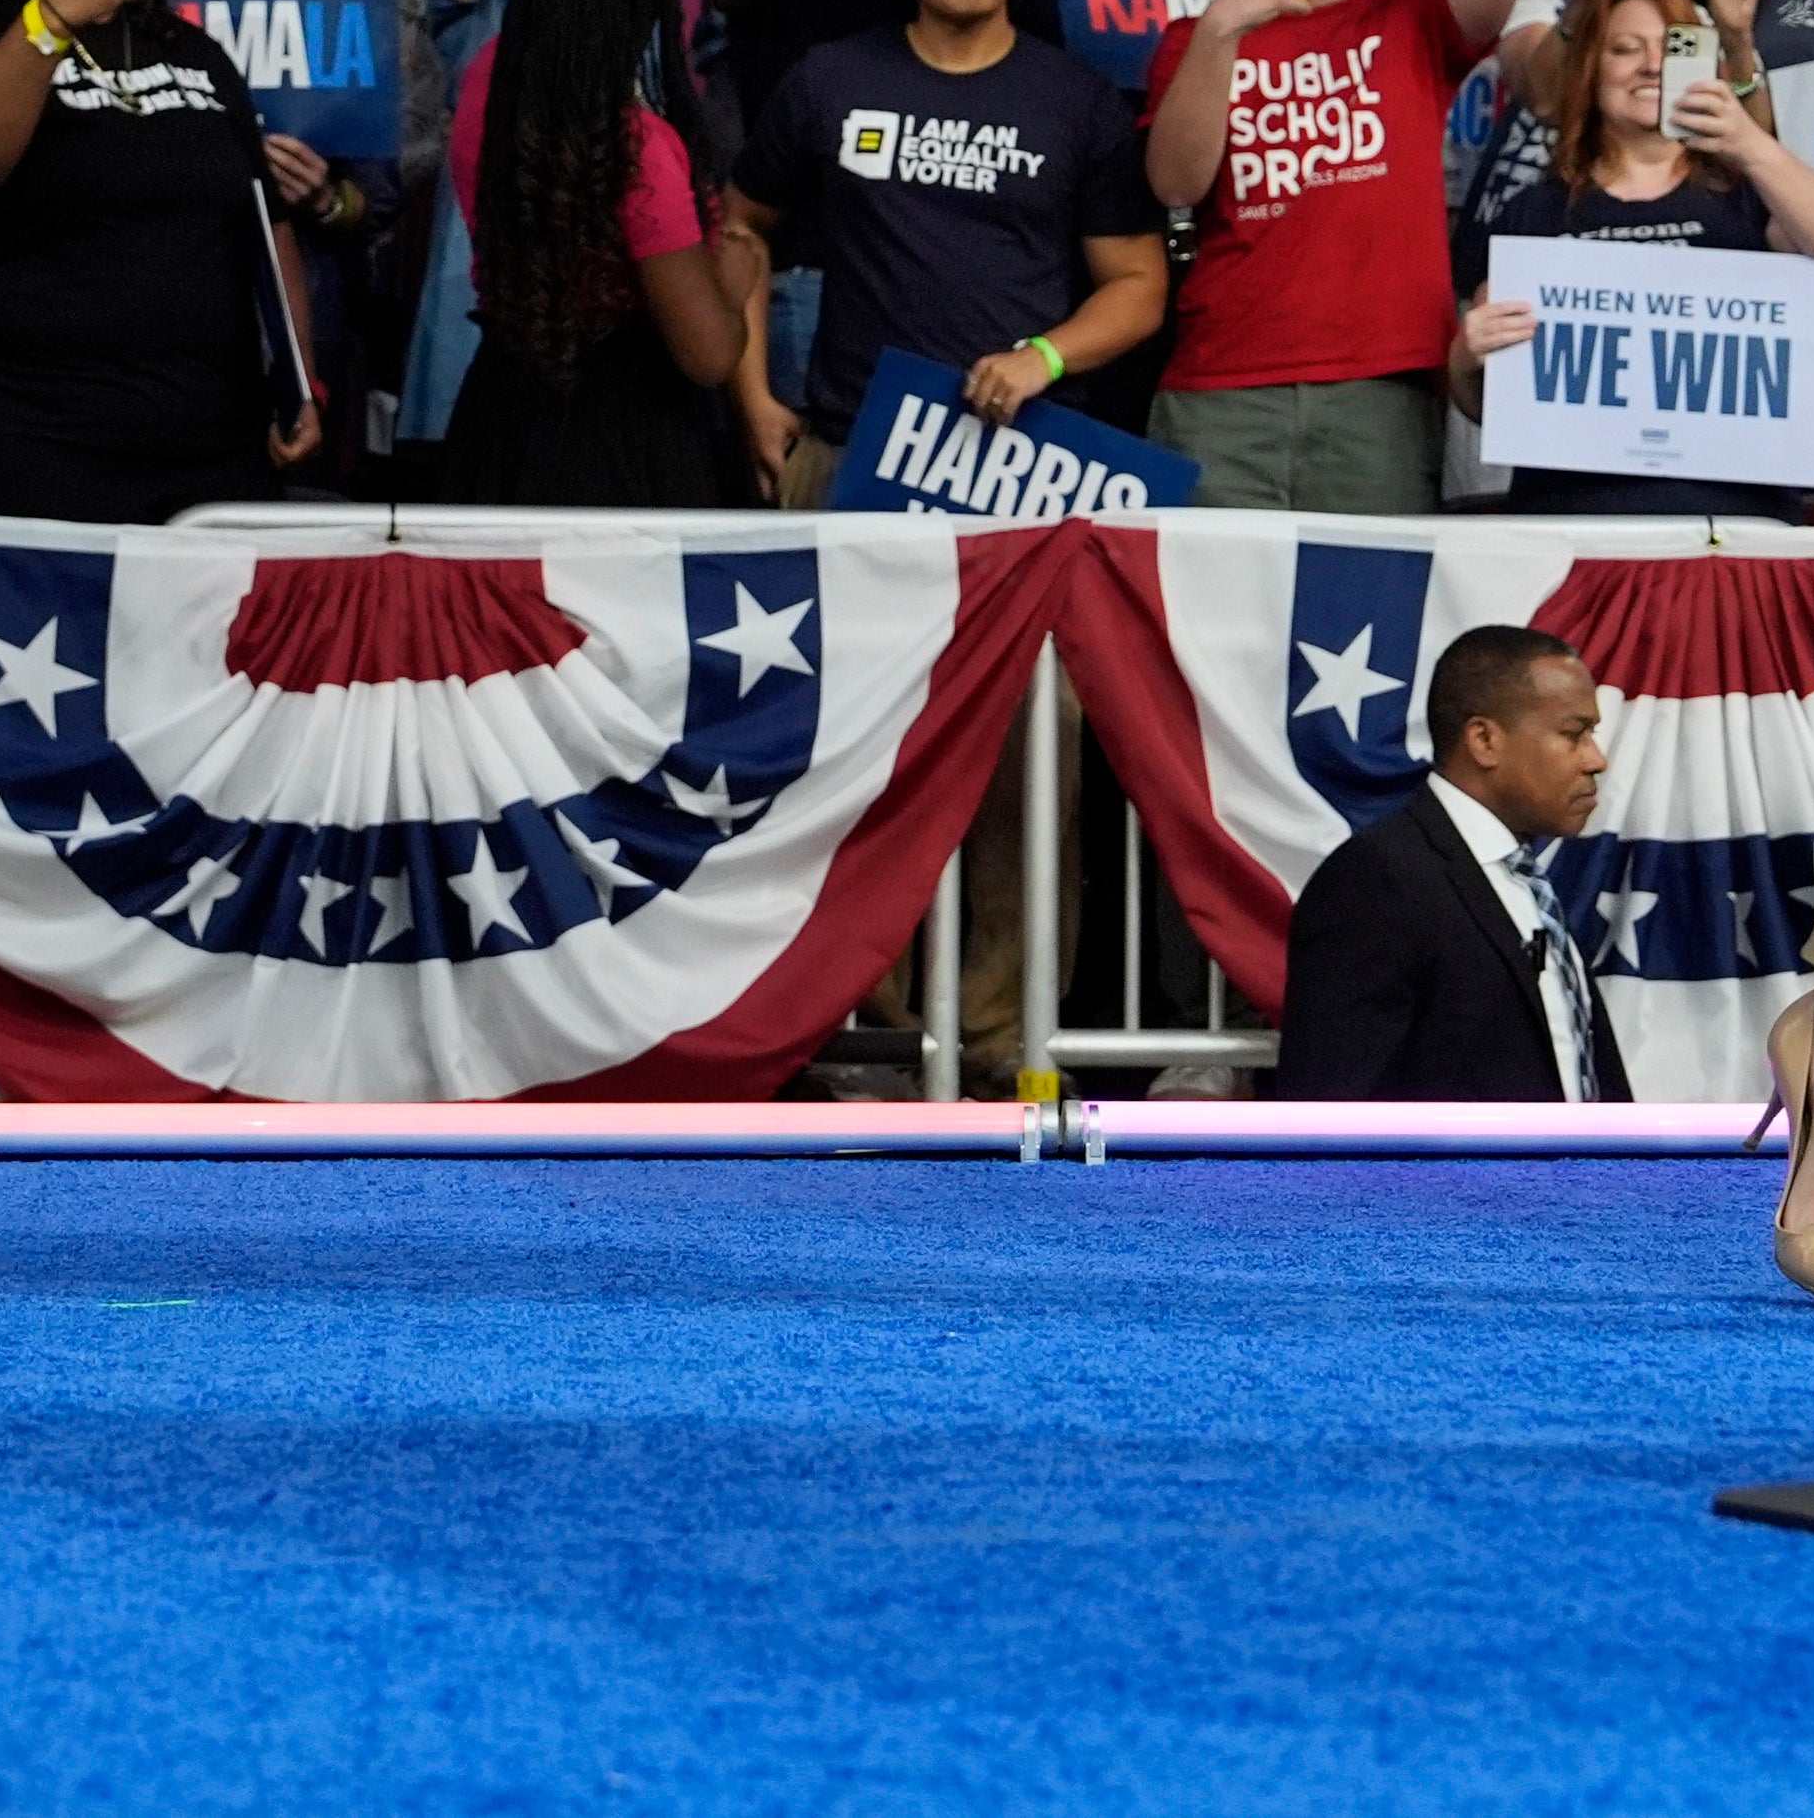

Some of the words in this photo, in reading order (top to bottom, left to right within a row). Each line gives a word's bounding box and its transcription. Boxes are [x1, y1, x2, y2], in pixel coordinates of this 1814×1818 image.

[903, 113, 915, 137] I
[917, 116, 967, 144] AM
[972, 123, 1018, 148] AN
[898, 156, 998, 194] VOTER
[900, 137, 1047, 179] EQUALITY
[1538, 285, 1635, 316] WHEN
[1646, 290, 1693, 318] WE
[1706, 294, 1788, 326] VOTE
[1532, 320, 1631, 408] WE
[1650, 328, 1792, 419] WIN
